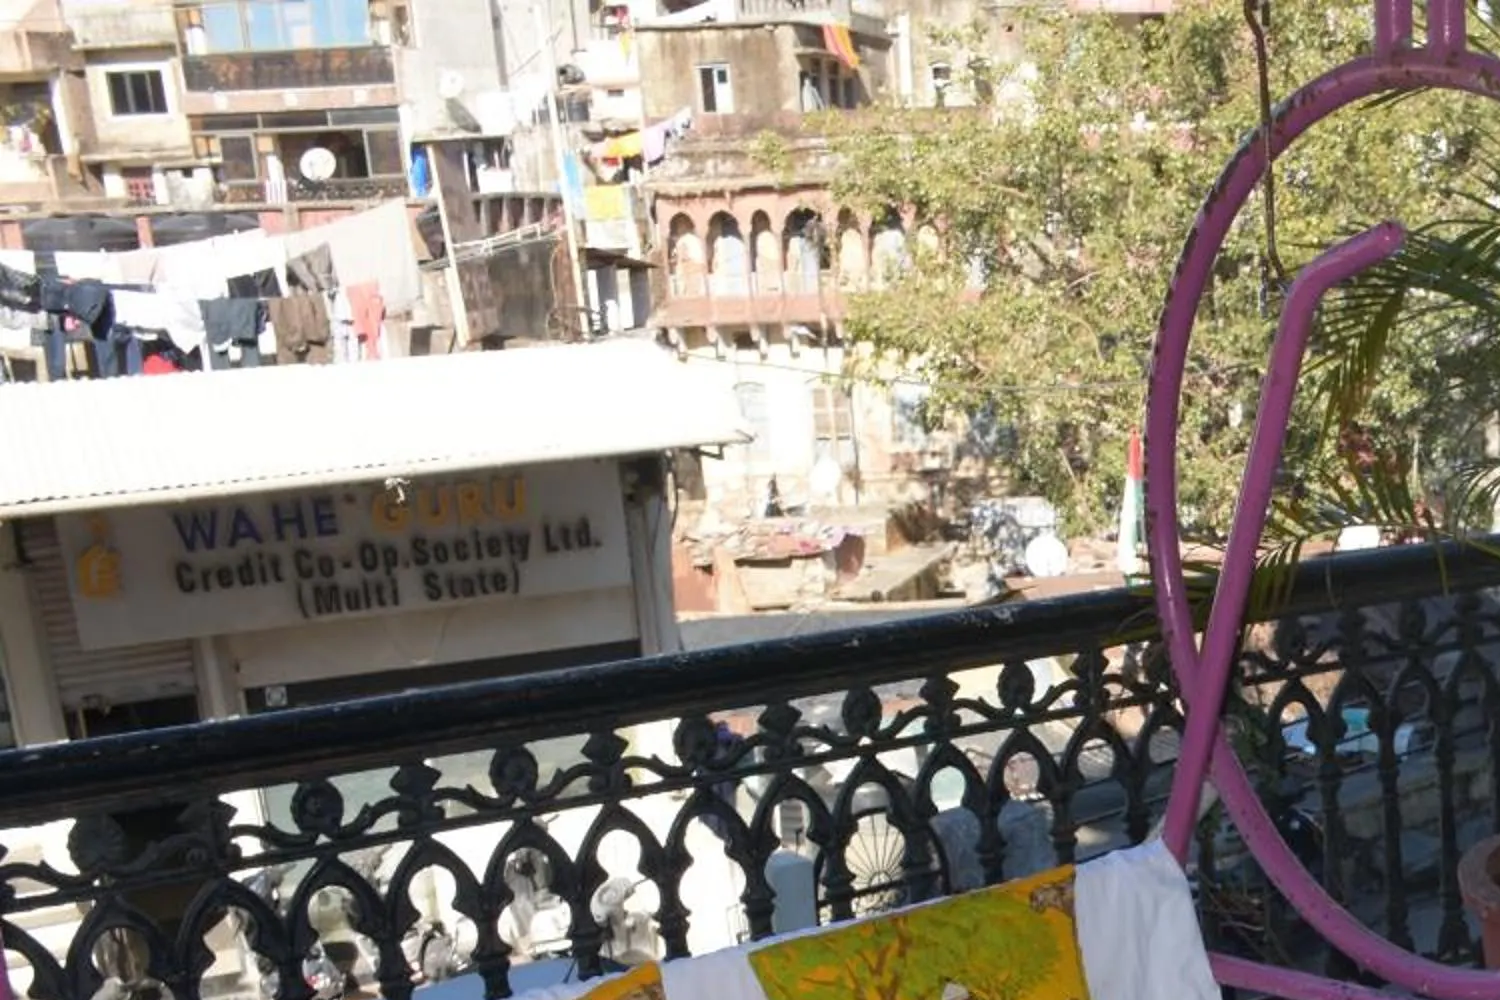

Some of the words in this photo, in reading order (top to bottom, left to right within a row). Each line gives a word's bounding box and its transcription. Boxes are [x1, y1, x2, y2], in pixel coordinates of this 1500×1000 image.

[172, 494, 339, 552] WAHE
[371, 475, 528, 534] GURU
[175, 556, 285, 593] Credit
[543, 517, 603, 553] Ltd.
[298, 576, 400, 618] (Multi
[422, 560, 521, 602] State)
